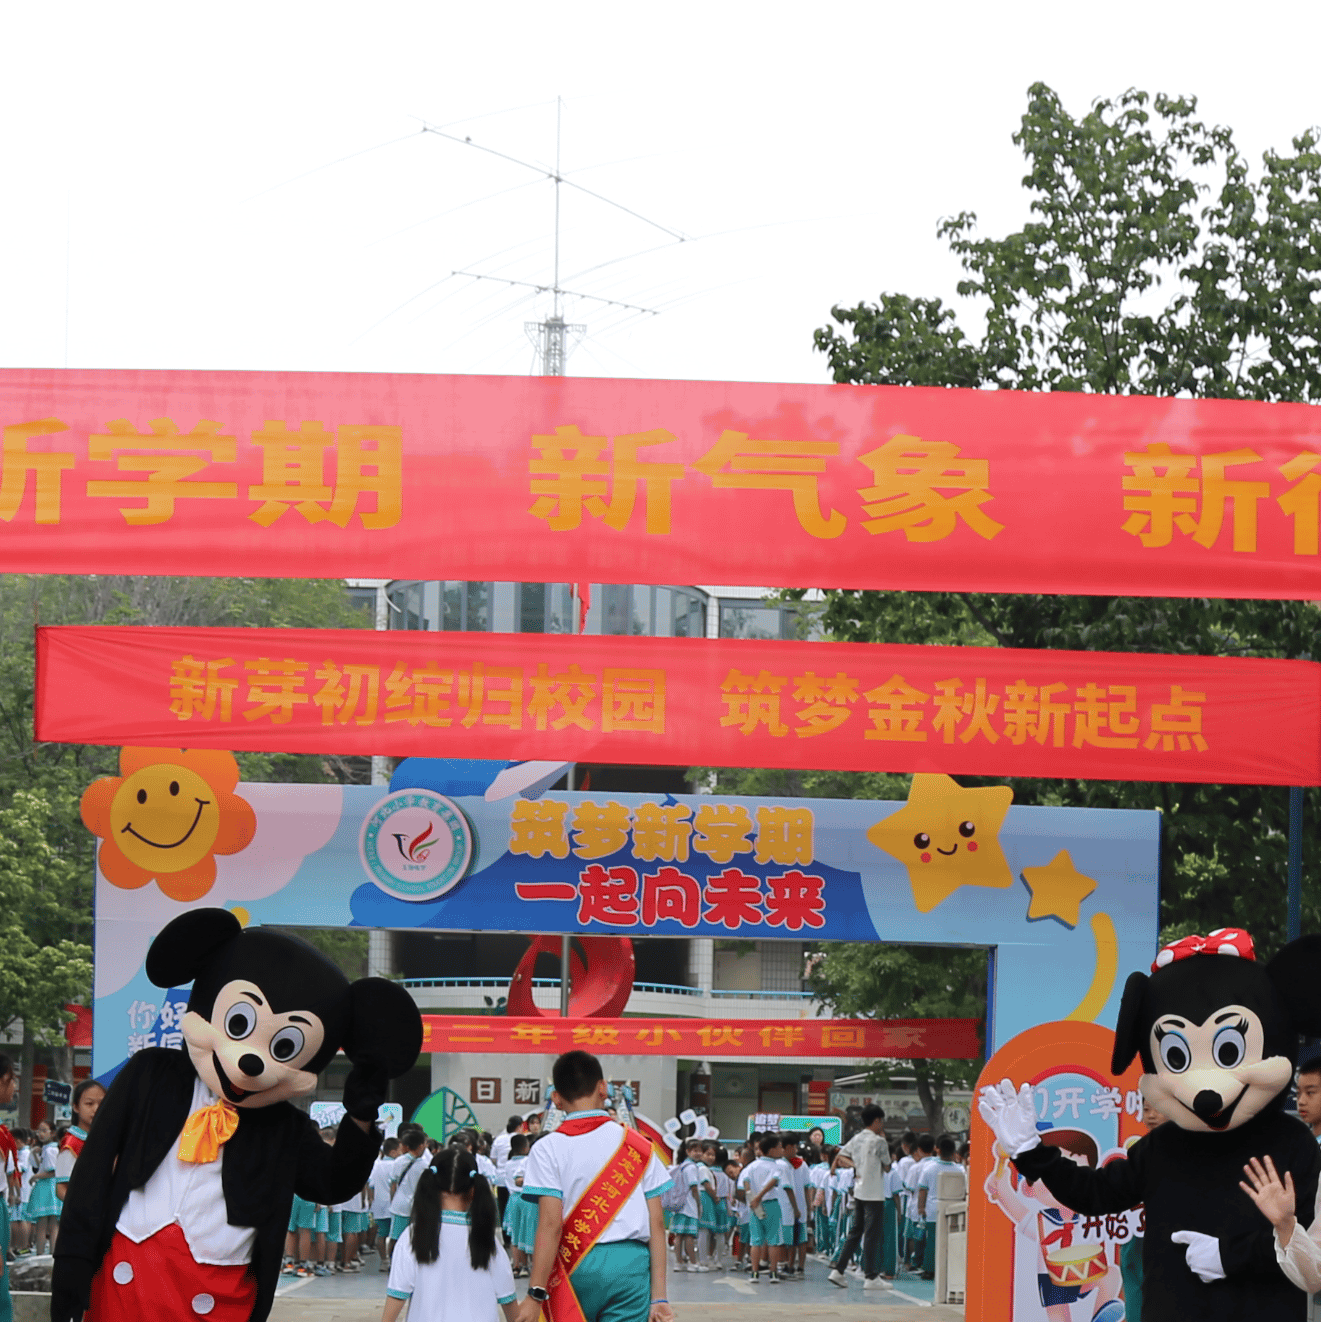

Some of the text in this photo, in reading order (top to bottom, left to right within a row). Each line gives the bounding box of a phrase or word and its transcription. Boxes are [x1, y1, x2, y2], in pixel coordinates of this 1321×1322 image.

[527, 424, 1005, 542] 新气象
[168, 654, 1210, 754] 新芽初绽归校园 筑梦金秋新起点
[509, 798, 816, 867] 筑梦新学期
[514, 863, 827, 930] 一起向未来
[127, 999, 189, 1031] 你好
[422, 1021, 928, 1050] 二年级小伙伴回家
